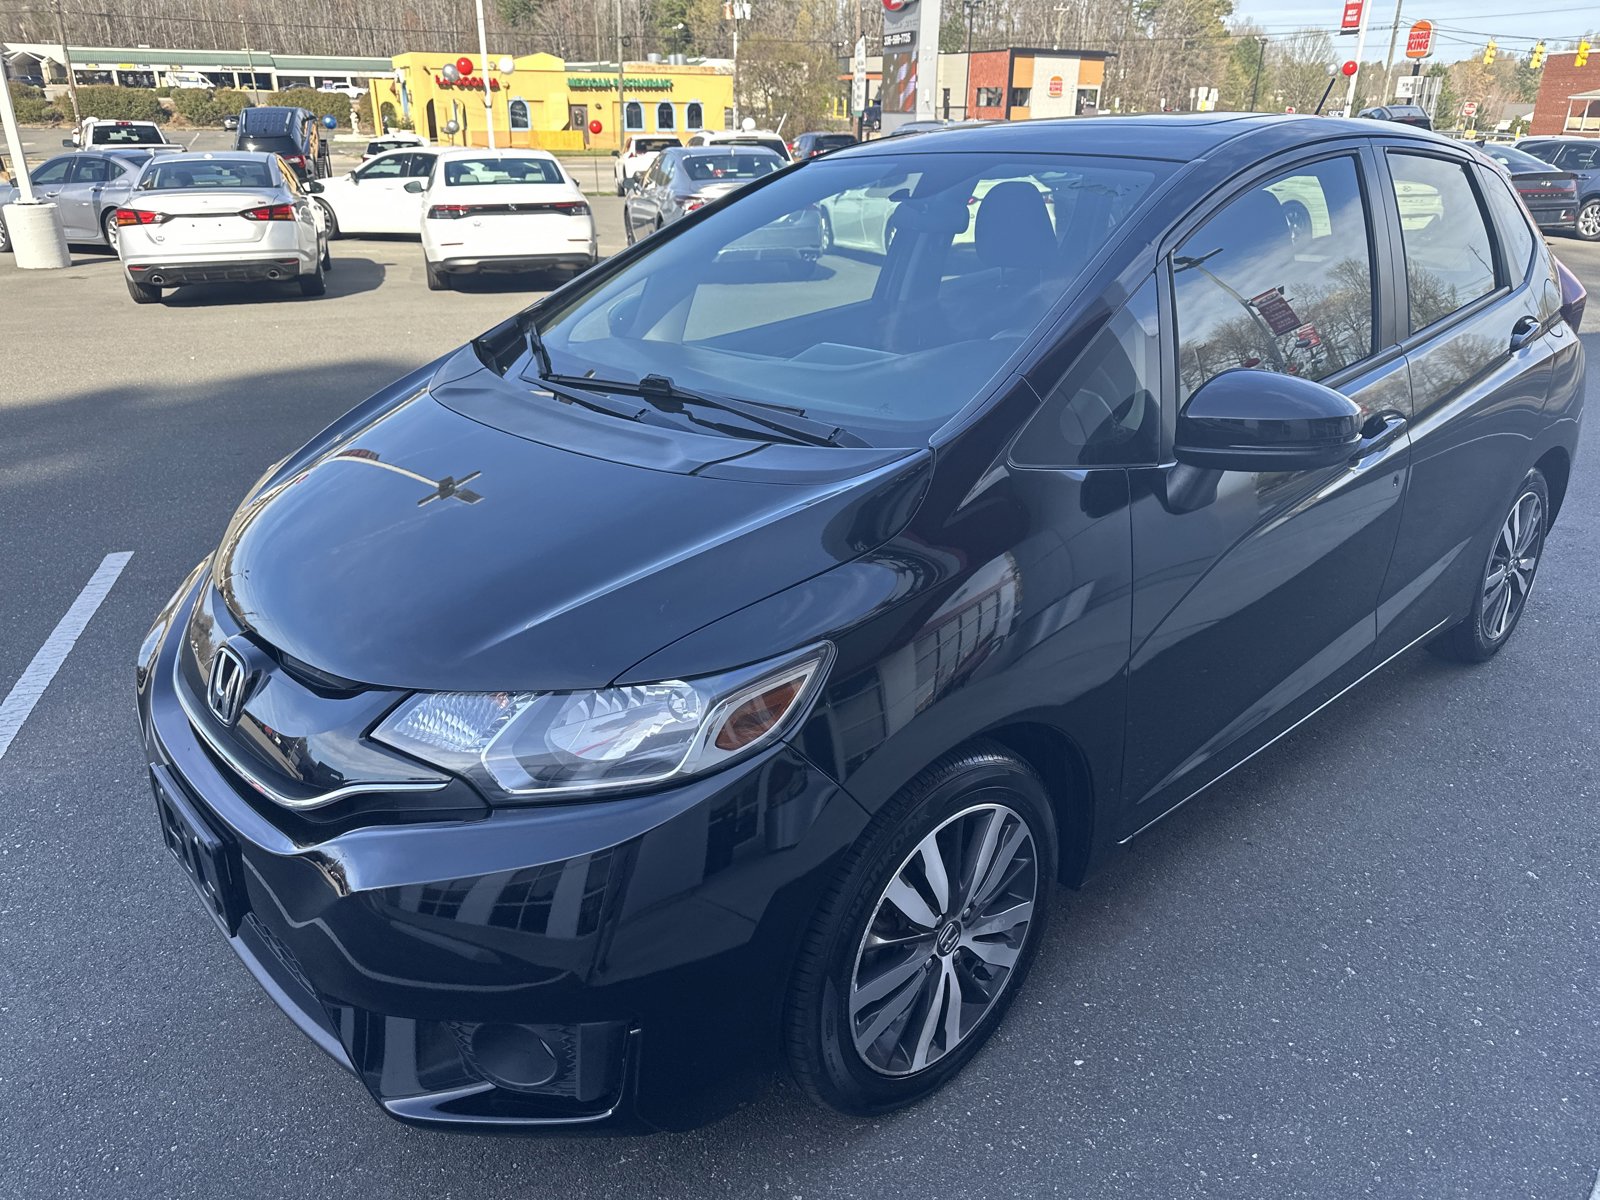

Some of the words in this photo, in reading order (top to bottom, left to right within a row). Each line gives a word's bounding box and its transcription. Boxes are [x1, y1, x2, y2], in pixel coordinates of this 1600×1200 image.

[1409, 32, 1430, 41] BURGER
[1407, 41, 1428, 50] KING
[568, 78, 612, 88] MEXICAN
[613, 78, 672, 88] RSTAURANT
